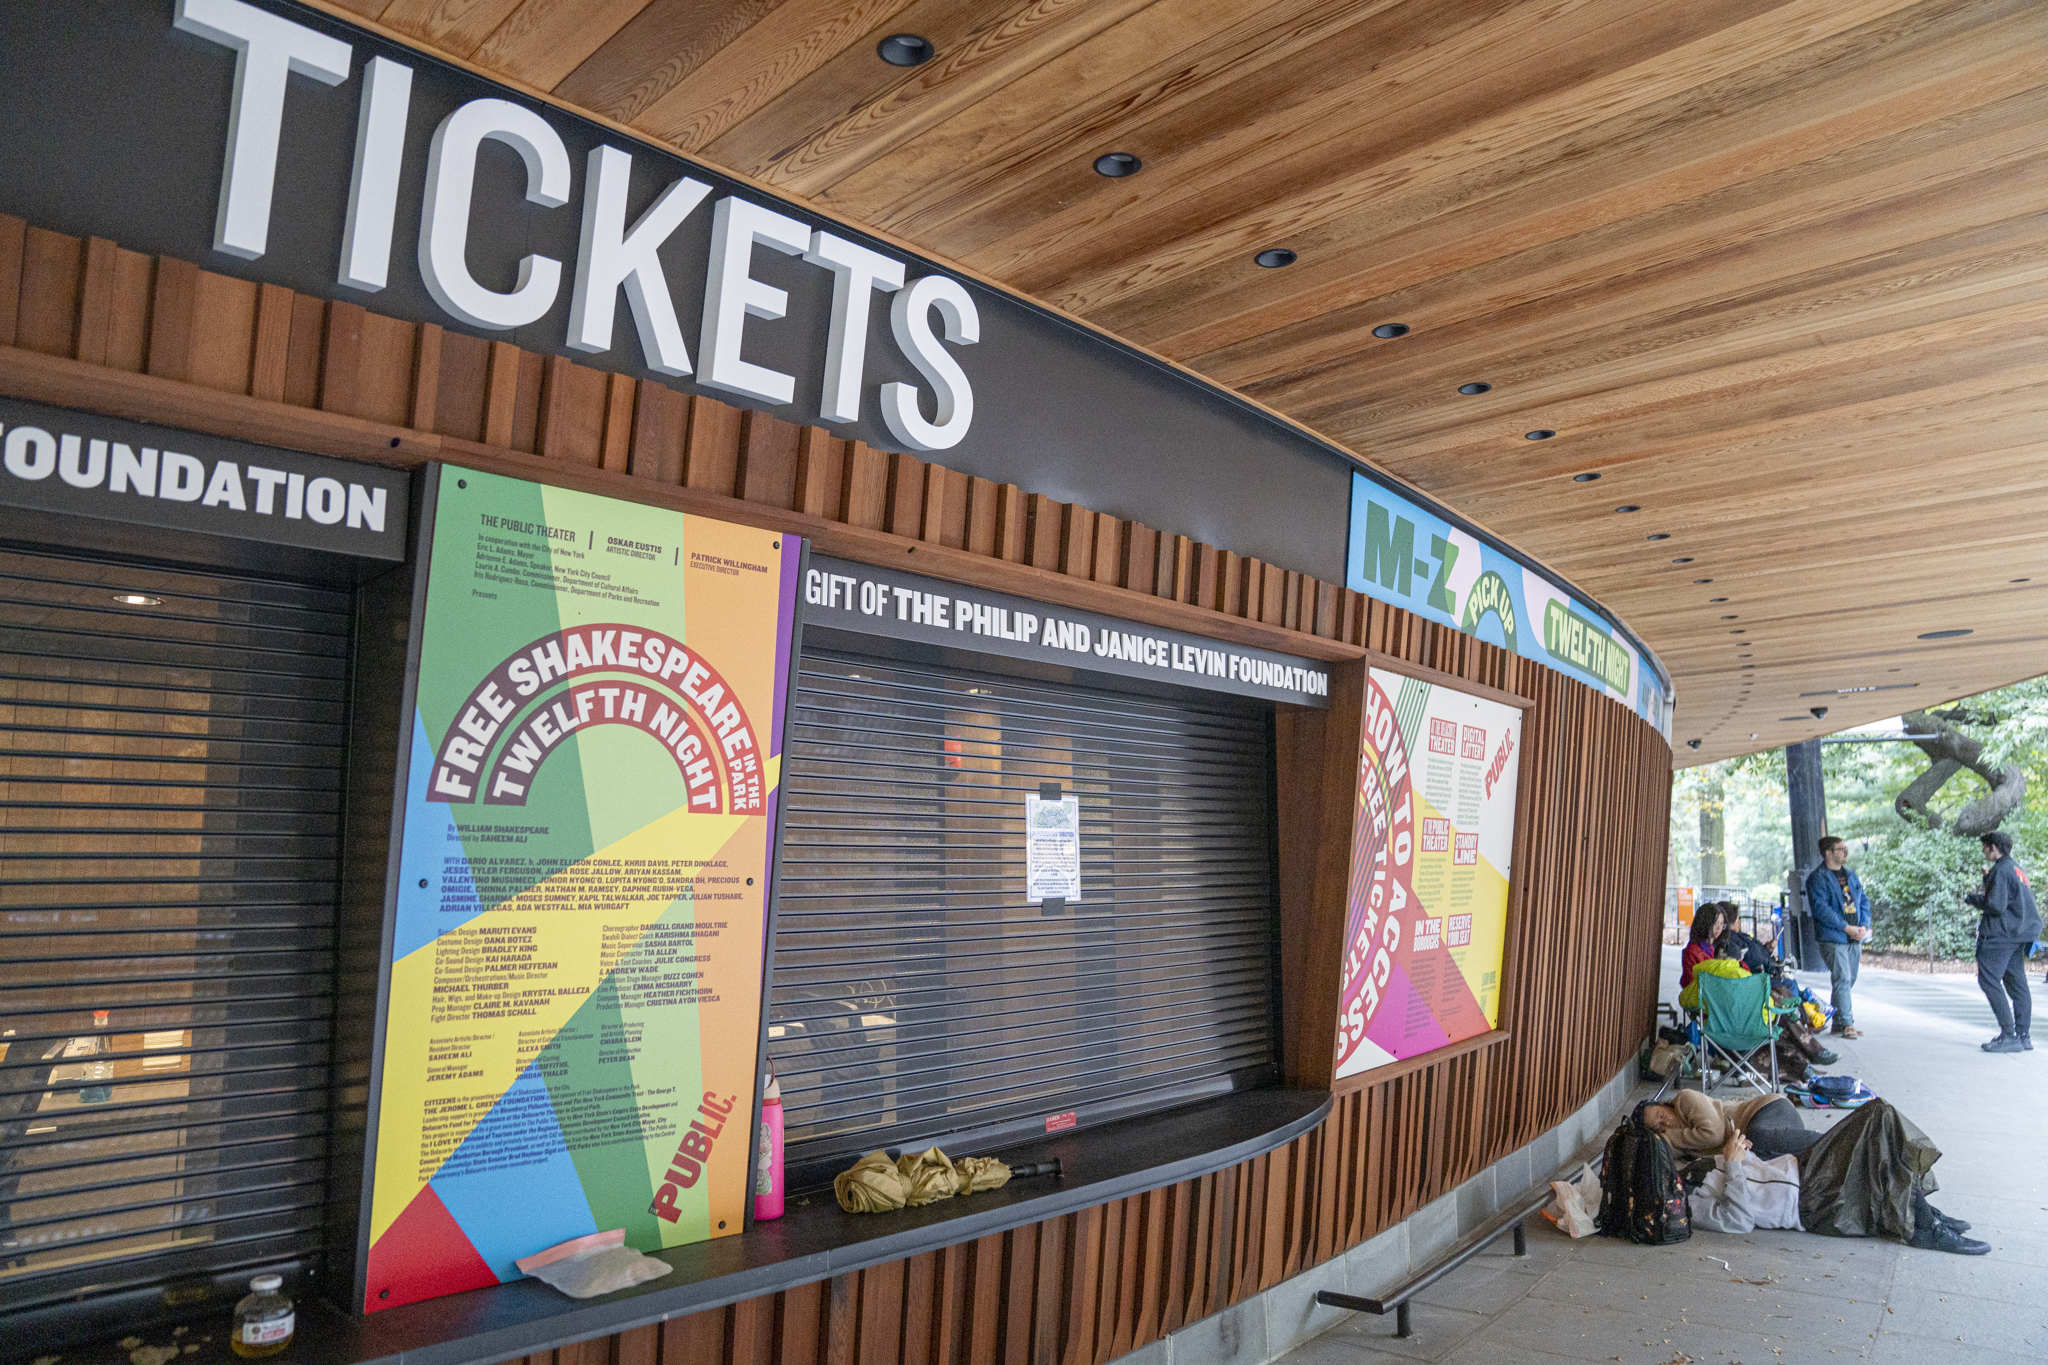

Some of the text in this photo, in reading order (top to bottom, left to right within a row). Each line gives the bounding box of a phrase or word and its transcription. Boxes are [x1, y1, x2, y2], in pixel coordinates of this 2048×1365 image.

[173, 0, 979, 451] TICKETS
[0, 422, 387, 533] OUNDATION
[481, 514, 575, 542] THE PUBLIC THEATER
[606, 546, 655, 560] ARTISTIC DIRECTOR
[608, 537, 662, 553] OSKAR EUSTIS
[691, 552, 767, 573] PATRICK WILLINGHAM
[1363, 499, 1459, 616] M-Z
[690, 561, 739, 576] EXECUTIVE DIRECTOR
[1468, 576, 1514, 634] PICK UP
[806, 569, 1327, 696] GIFT OF THE PHILIP AND JANICE LEVIN FOUNDATION
[1550, 604, 1628, 691] TWELFTH NIGHT
[435, 630, 752, 798] FREE SHAKESPEARE
[1464, 726, 1485, 745] DIGITAL
[492, 688, 717, 809] TWELFTH NIGHT
[1430, 736, 1455, 754] THEATER
[1462, 742, 1484, 760] LOTTERY
[743, 754, 760, 809] IN THE
[1364, 683, 1406, 789] HOW
[1394, 791, 1411, 866] TO
[730, 759, 746, 810] PARK
[448, 824, 549, 834] By WILLIAM SHAKESPEARE
[1433, 820, 1449, 835] PUBLIC
[472, 835, 479, 843] by
[1423, 835, 1448, 851] THEATER
[1455, 835, 1477, 849] STANDBY
[488, 858, 527, 866] ALVAREZ,
[1454, 850, 1476, 864] LINE
[499, 867, 543, 875] FERGUSON,
[491, 876, 536, 884] MUSUMECI,
[1415, 919, 1441, 935] IN THE
[1449, 915, 1471, 931] RESERVE
[1448, 930, 1470, 946] YOUR SEAT
[485, 962, 557, 972] PALMER HEFFERAN
[605, 967, 636, 975] ANDREW
[472, 983, 509, 991] THURBER
[558, 987, 590, 995] BALLEZA
[656, 981, 692, 989] MCSHARRY
[676, 988, 712, 996] FICHTHORN
[474, 1002, 500, 1010] CLAIRE
[514, 999, 550, 1007] KAVANAH
[698, 995, 720, 1003] VIESCA
[472, 1008, 536, 1019] THOMAS SCHALL
